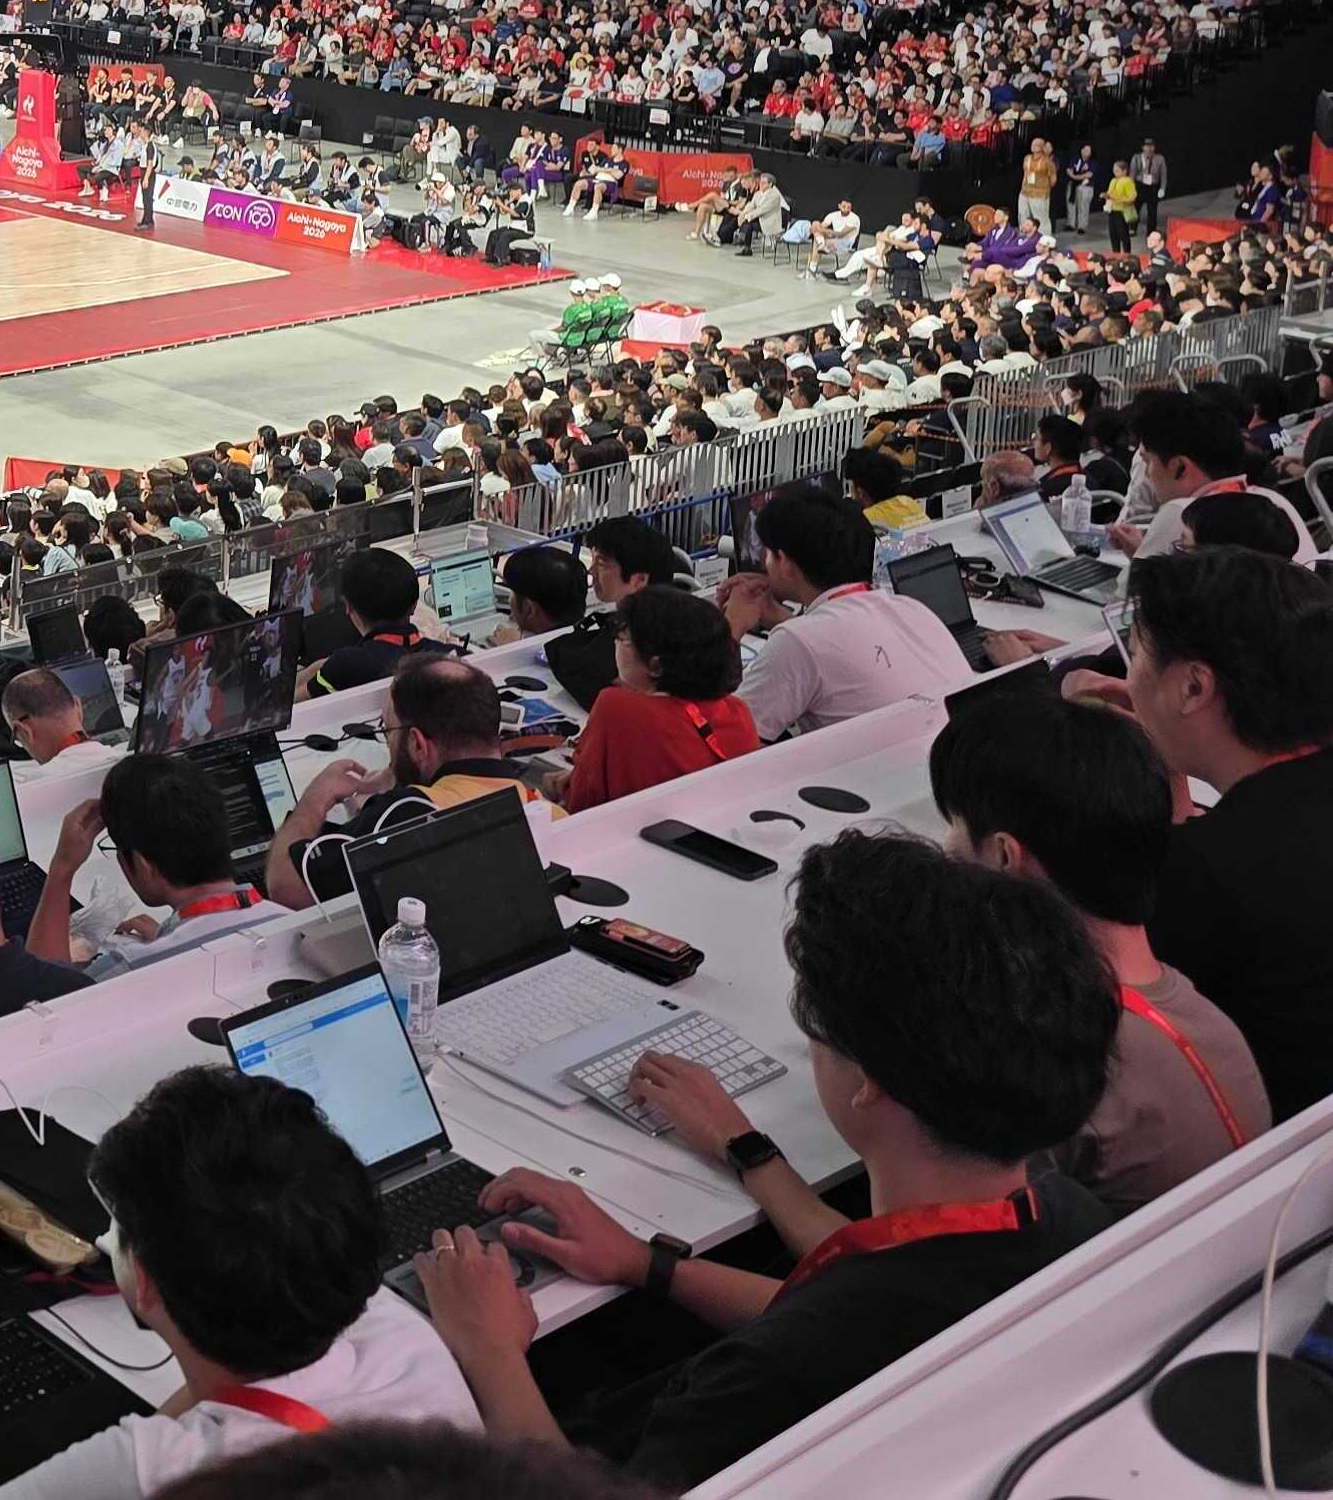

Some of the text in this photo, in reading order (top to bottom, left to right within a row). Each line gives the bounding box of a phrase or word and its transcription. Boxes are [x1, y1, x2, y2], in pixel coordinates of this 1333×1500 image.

[15, 145, 40, 159] Aichi-
[11, 154, 43, 170] Nagoya
[16, 165, 37, 179] 2026
[287, 211, 347, 233] Aichi-Nagoya
[303, 225, 326, 239] 2026
